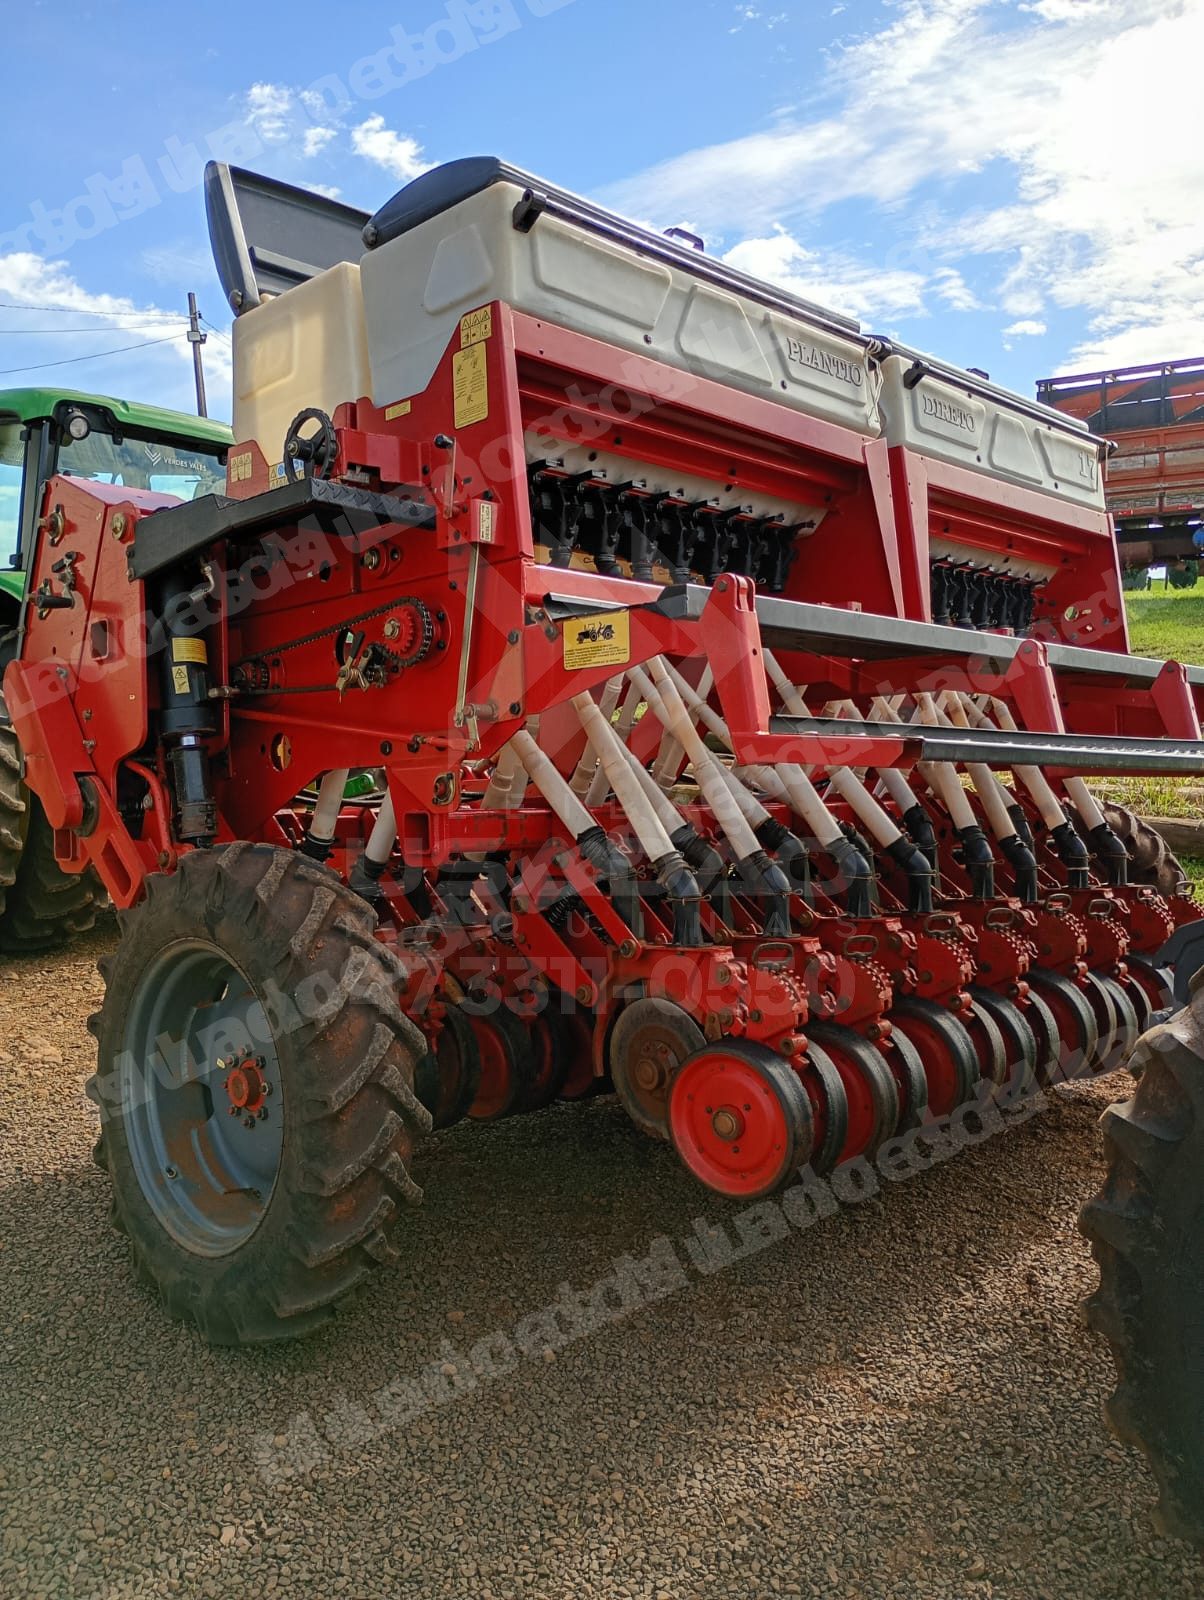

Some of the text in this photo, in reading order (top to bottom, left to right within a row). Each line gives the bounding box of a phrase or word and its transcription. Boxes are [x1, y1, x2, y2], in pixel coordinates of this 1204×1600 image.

[786, 336, 863, 387] PLANTIO
[922, 393, 975, 433] DIRETO
[163, 455, 207, 472] VERDES VALES
[1078, 451, 1095, 481] 17
